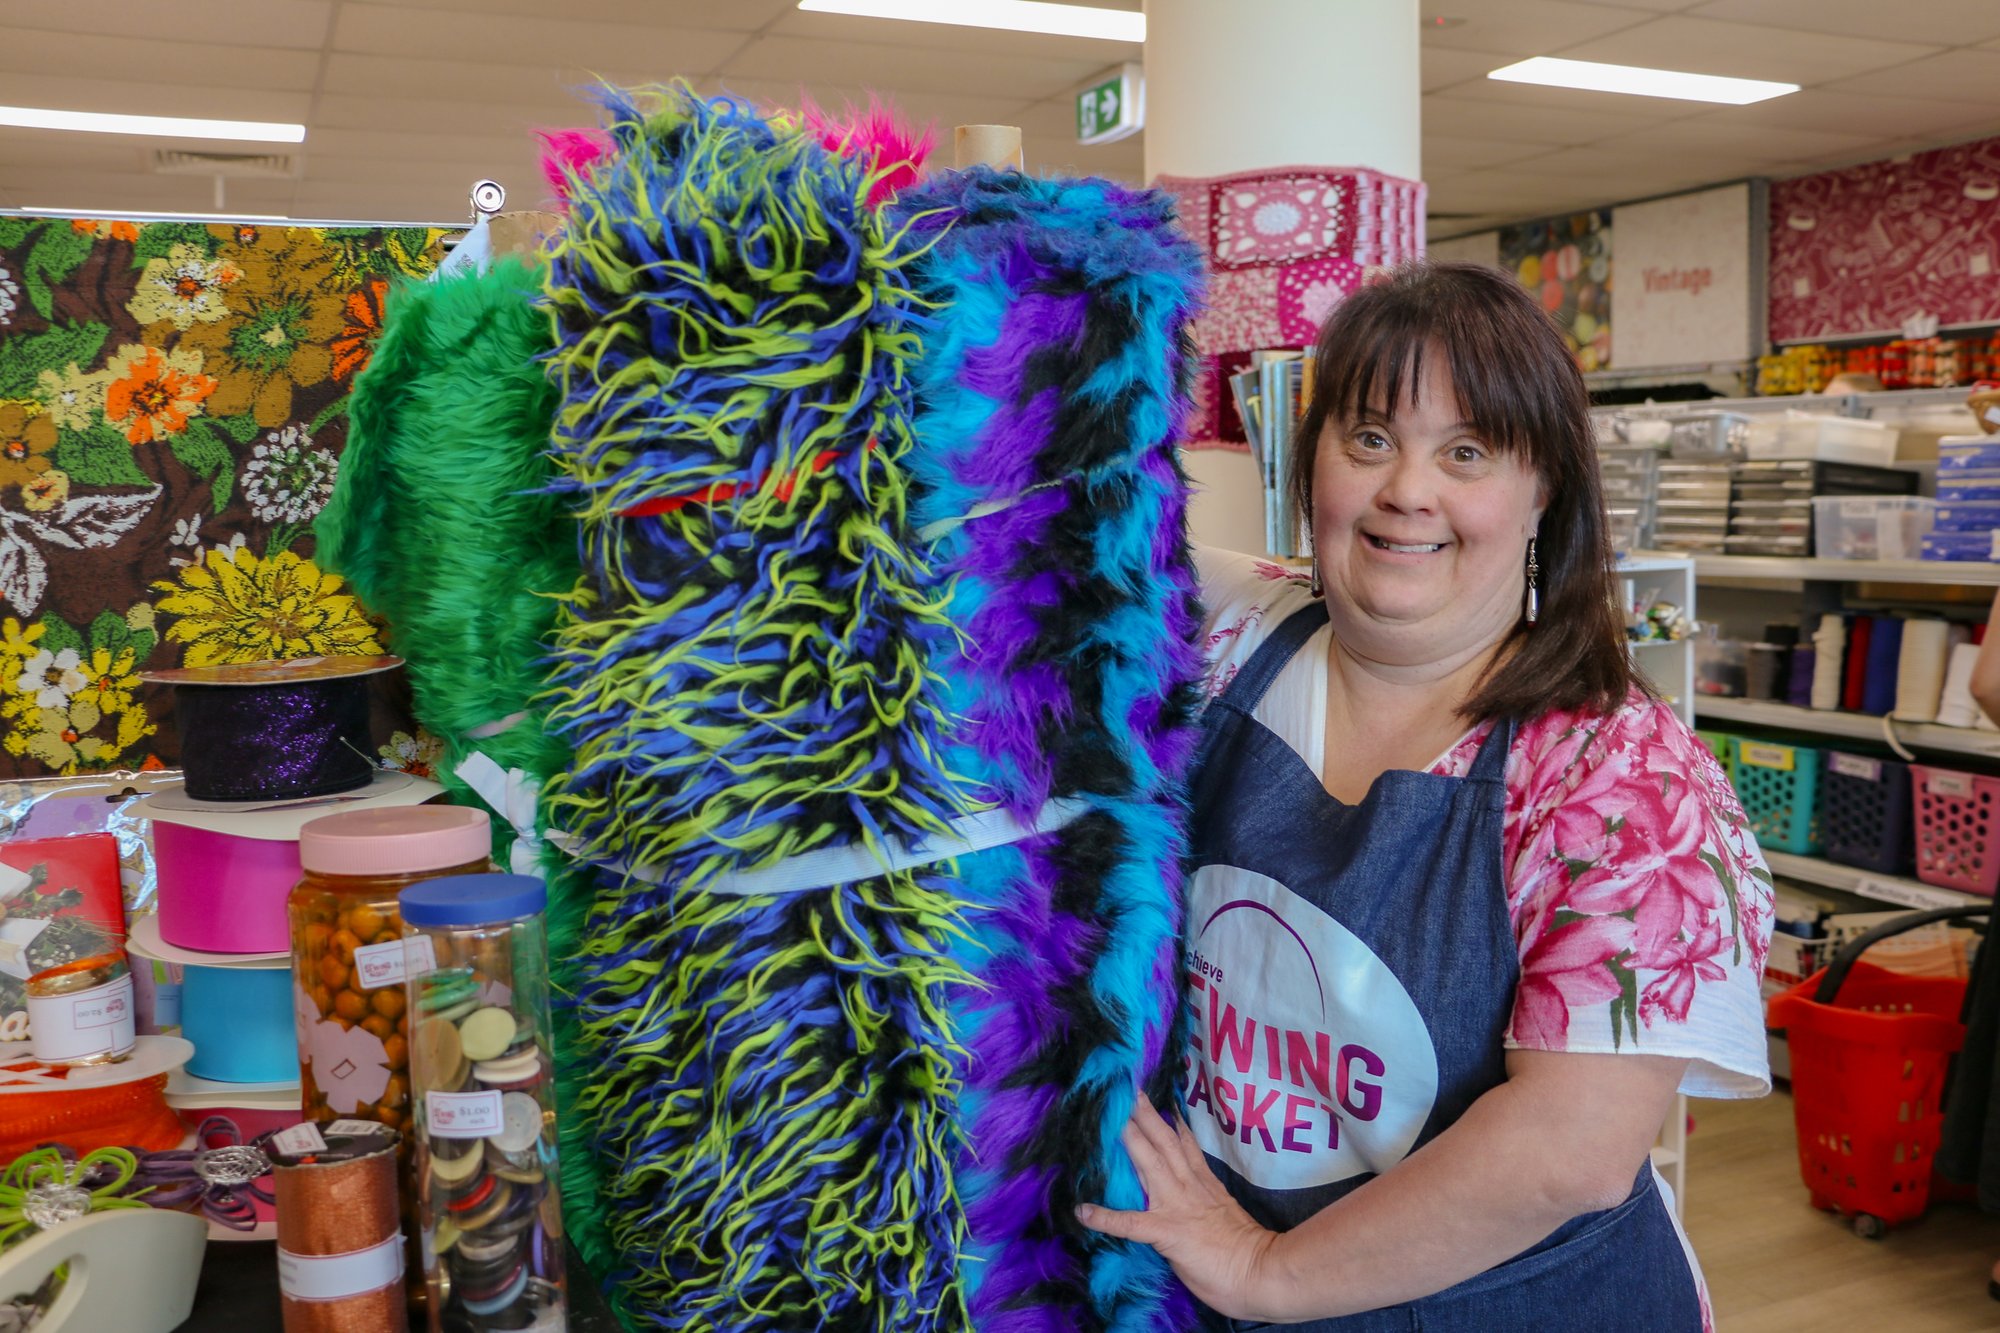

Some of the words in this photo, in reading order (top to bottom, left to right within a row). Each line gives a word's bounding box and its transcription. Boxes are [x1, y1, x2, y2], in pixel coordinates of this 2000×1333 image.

[1642, 266, 1712, 296] Vintage
[1187, 950, 1223, 983] chieve
[1188, 971, 1386, 1122] EWING
